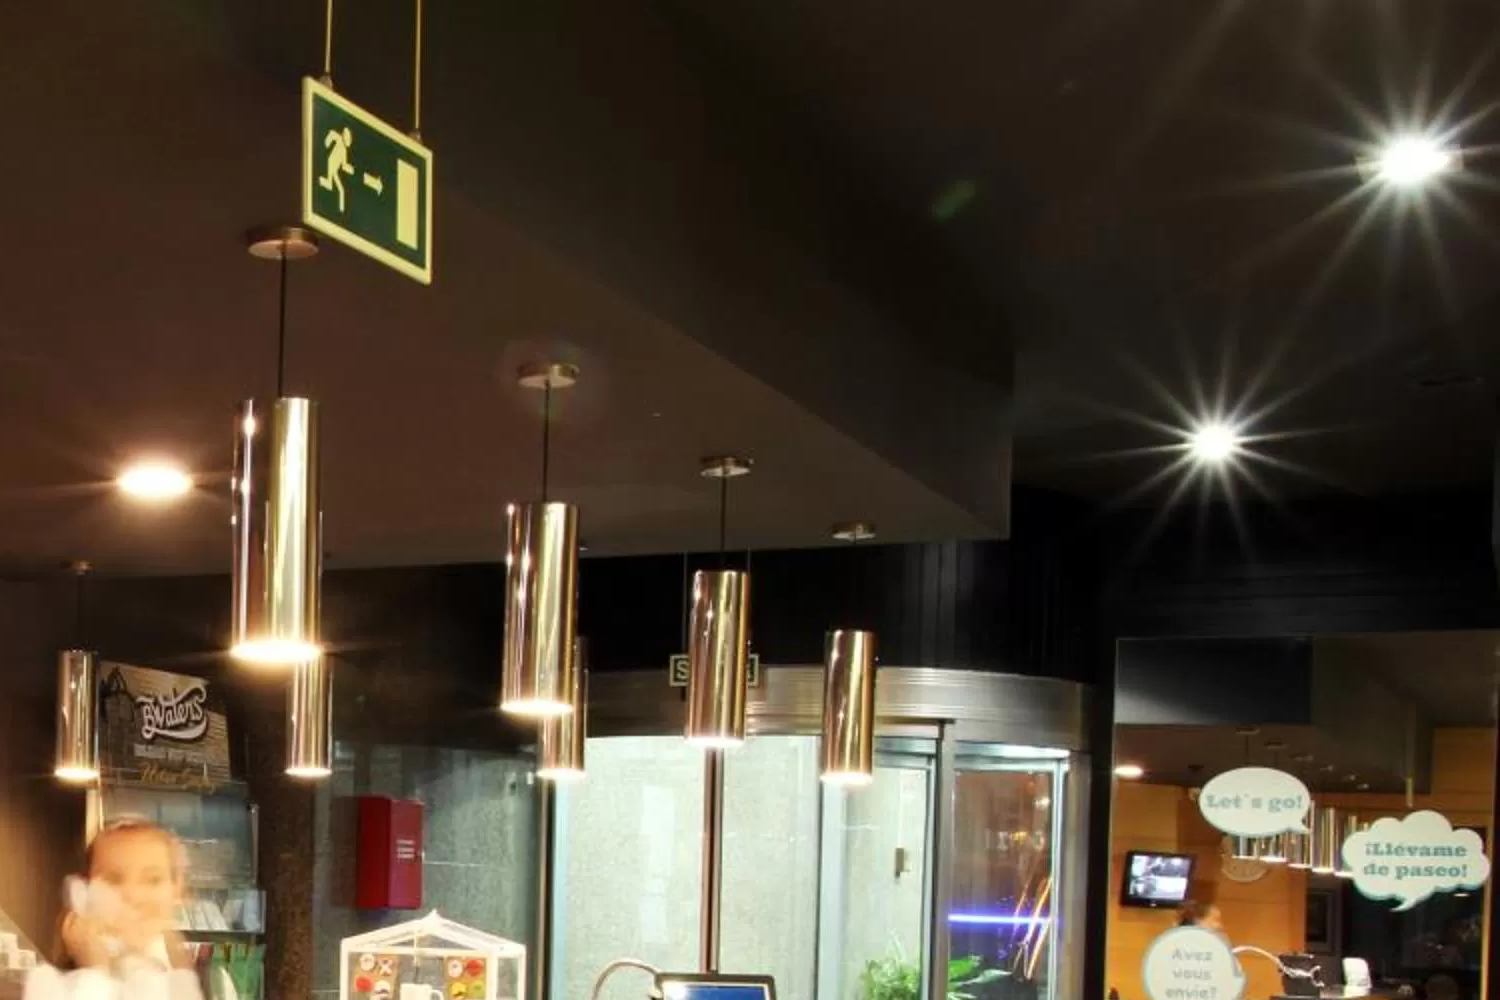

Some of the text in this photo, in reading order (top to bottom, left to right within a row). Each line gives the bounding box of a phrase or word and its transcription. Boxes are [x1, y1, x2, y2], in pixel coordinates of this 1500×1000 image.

[1268, 795, 1303, 813] go!
[1363, 862, 1469, 880] de paseo!
